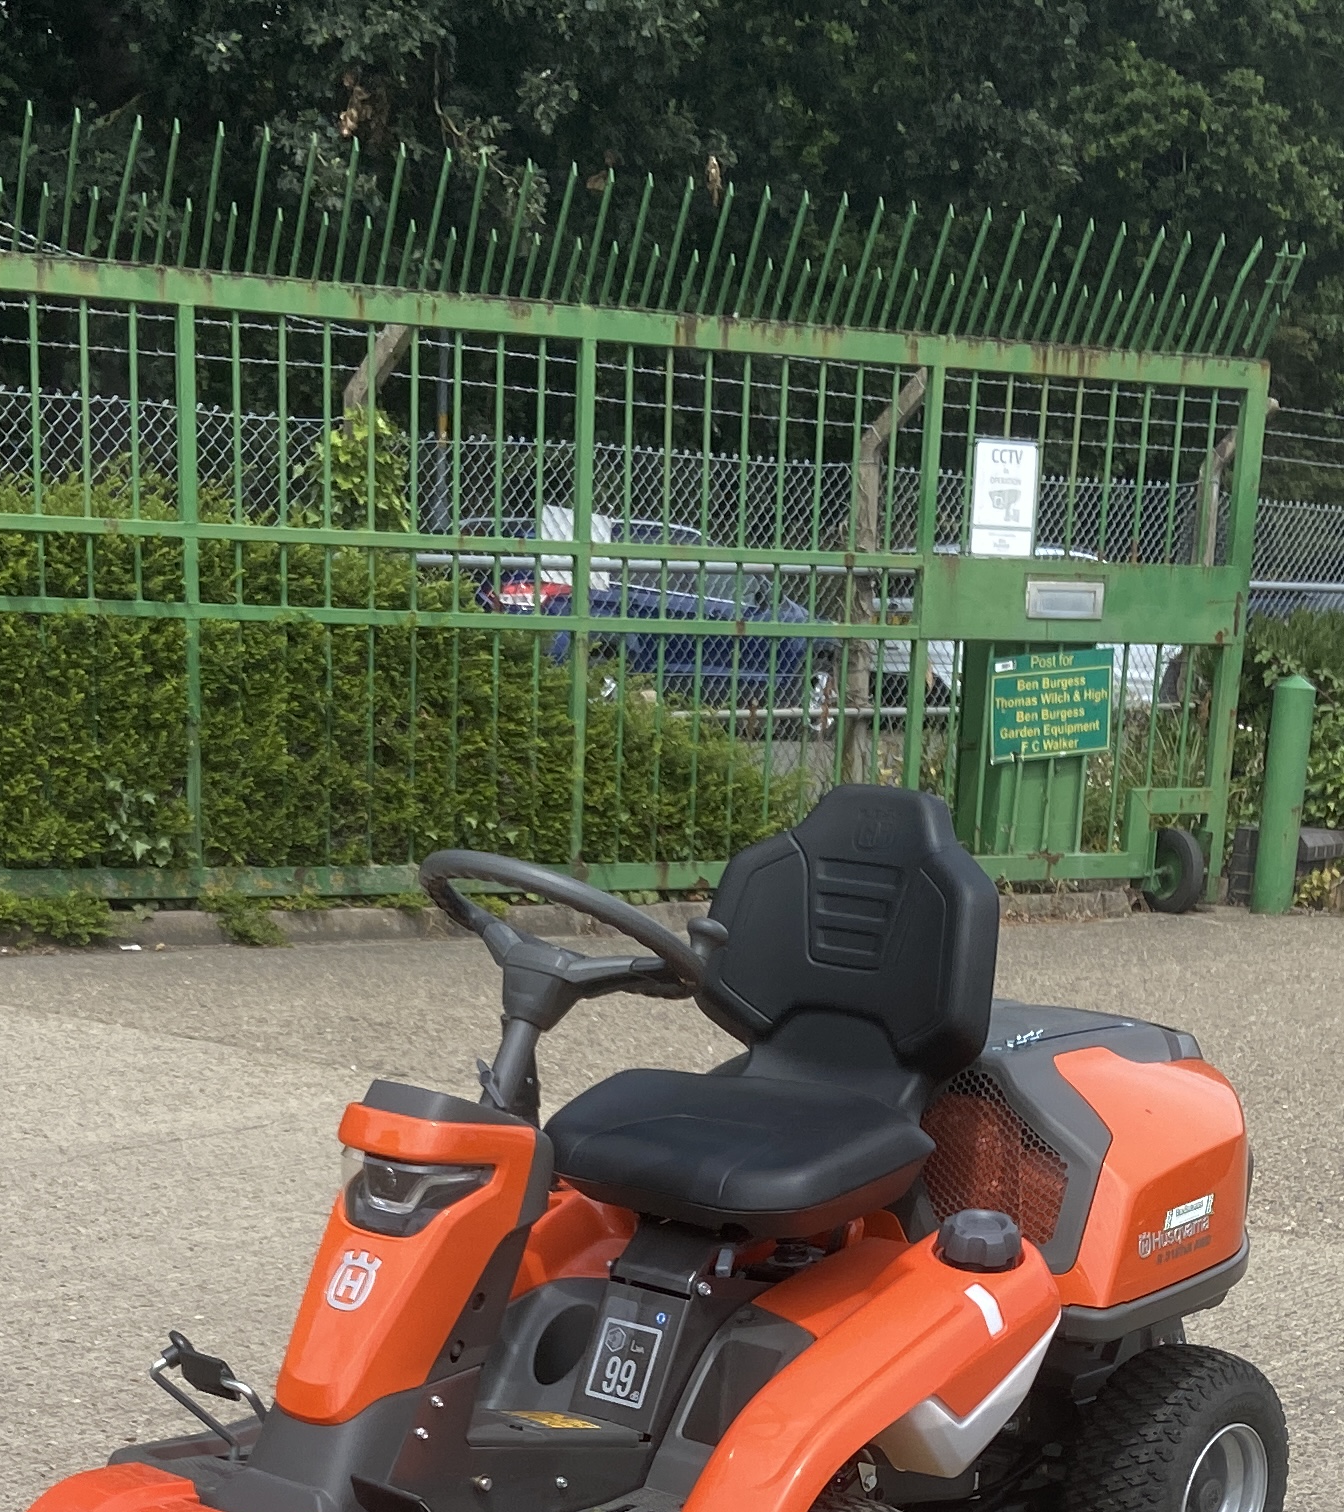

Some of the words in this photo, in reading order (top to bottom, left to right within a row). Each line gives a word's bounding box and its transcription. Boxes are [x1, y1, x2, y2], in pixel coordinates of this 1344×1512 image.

[991, 448, 1024, 465] CCTV
[1030, 655, 1057, 669] Post
[1059, 653, 1074, 667] for
[1017, 679, 1039, 691] Ben
[1042, 676, 1086, 691] Burgess
[995, 696, 1038, 710] Thomas
[1073, 690, 1081, 702] &
[1084, 688, 1108, 704] High
[1016, 710, 1038, 723] Ben
[1041, 707, 1085, 722] Burgess
[1000, 726, 1041, 740] Garden
[1043, 719, 1100, 737] Equipment
[1021, 741, 1029, 753] F
[1042, 738, 1079, 751] Walker
[1152, 1215, 1210, 1251] Husqvarna
[602, 1356, 637, 1398] 99
